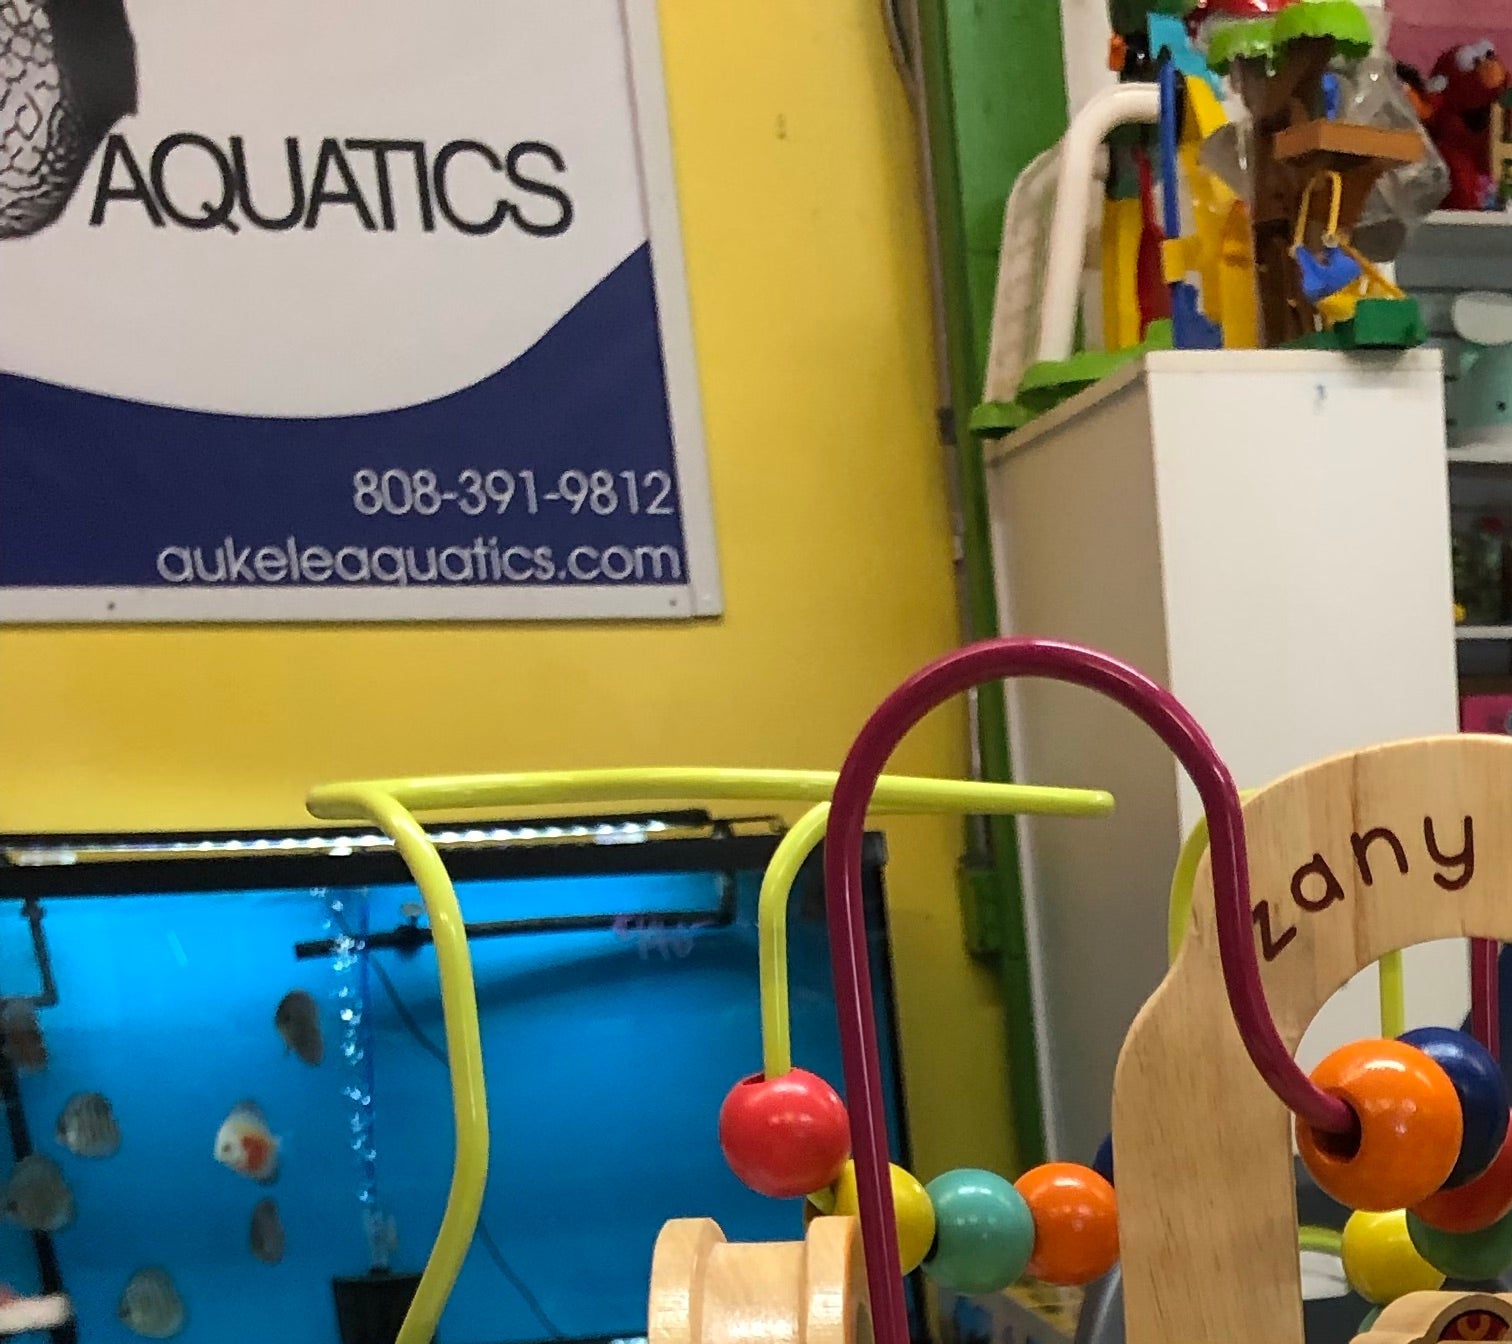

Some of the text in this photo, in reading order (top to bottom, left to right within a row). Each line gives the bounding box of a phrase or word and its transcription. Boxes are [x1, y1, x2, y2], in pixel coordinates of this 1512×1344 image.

[89, 132, 574, 237] AQUATICS
[352, 468, 675, 518] 808-391-9812
[156, 535, 683, 586] aukeleaquatics.com
[1251, 815, 1475, 962] zany
